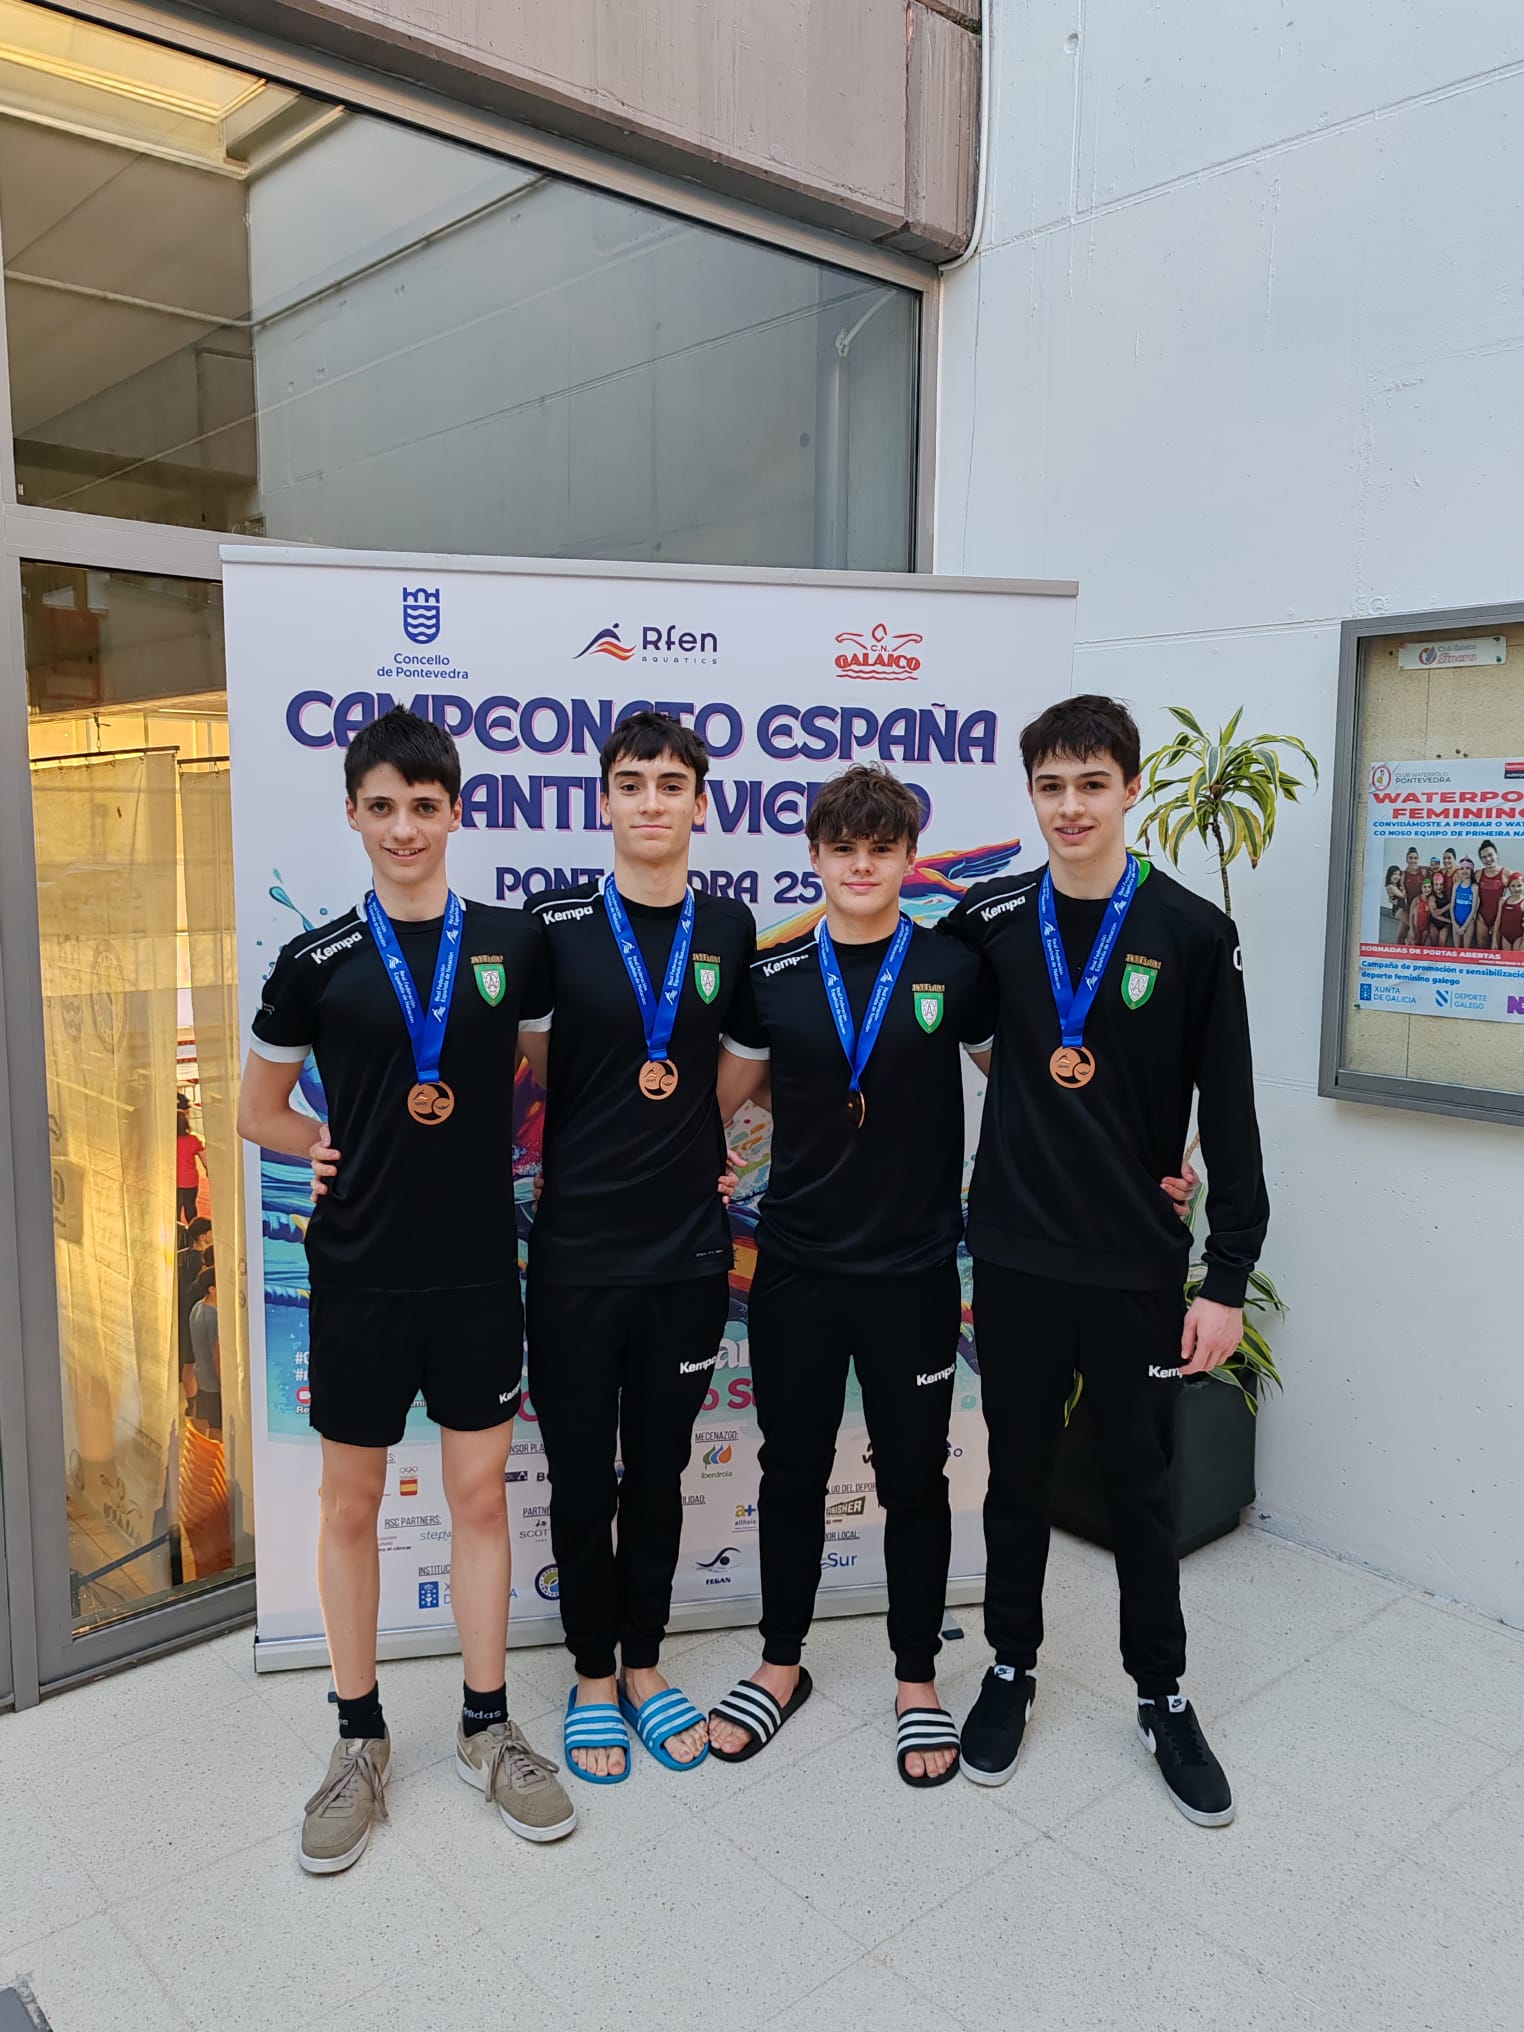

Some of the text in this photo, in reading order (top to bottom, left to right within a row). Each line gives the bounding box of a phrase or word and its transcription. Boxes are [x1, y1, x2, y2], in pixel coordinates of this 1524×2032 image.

[642, 624, 718, 652] Rfen
[870, 644, 890, 652] C.N.
[394, 652, 450, 666] Concello
[641, 656, 718, 664] AQUATICS
[834, 652, 921, 671] GALAICO
[377, 666, 469, 680] de Pontevedra
[757, 703, 998, 765] ESPAÑA
[1395, 776, 1451, 784] PONTEVEDRA
[774, 871, 823, 904] 25
[542, 905, 594, 925] Kempa
[981, 895, 1026, 922] Kempa
[311, 931, 363, 965] Kempa
[1423, 949, 1457, 957] PORTAS
[1459, 952, 1502, 960] ABERTAS
[1361, 960, 1399, 970] Campaña
[1401, 962, 1411, 970] de
[1413, 963, 1457, 974] promoción
[1361, 971, 1460, 986] deporte feminino galego
[1374, 986, 1401, 994] XUNTA
[1454, 992, 1488, 1002] DEPORTE
[1385, 995, 1417, 1004] GALICIA
[1454, 1001, 1485, 1010] GALEGO
[1148, 1364, 1183, 1378] Kem
[695, 1430, 738, 1441] MECENAZGO:
